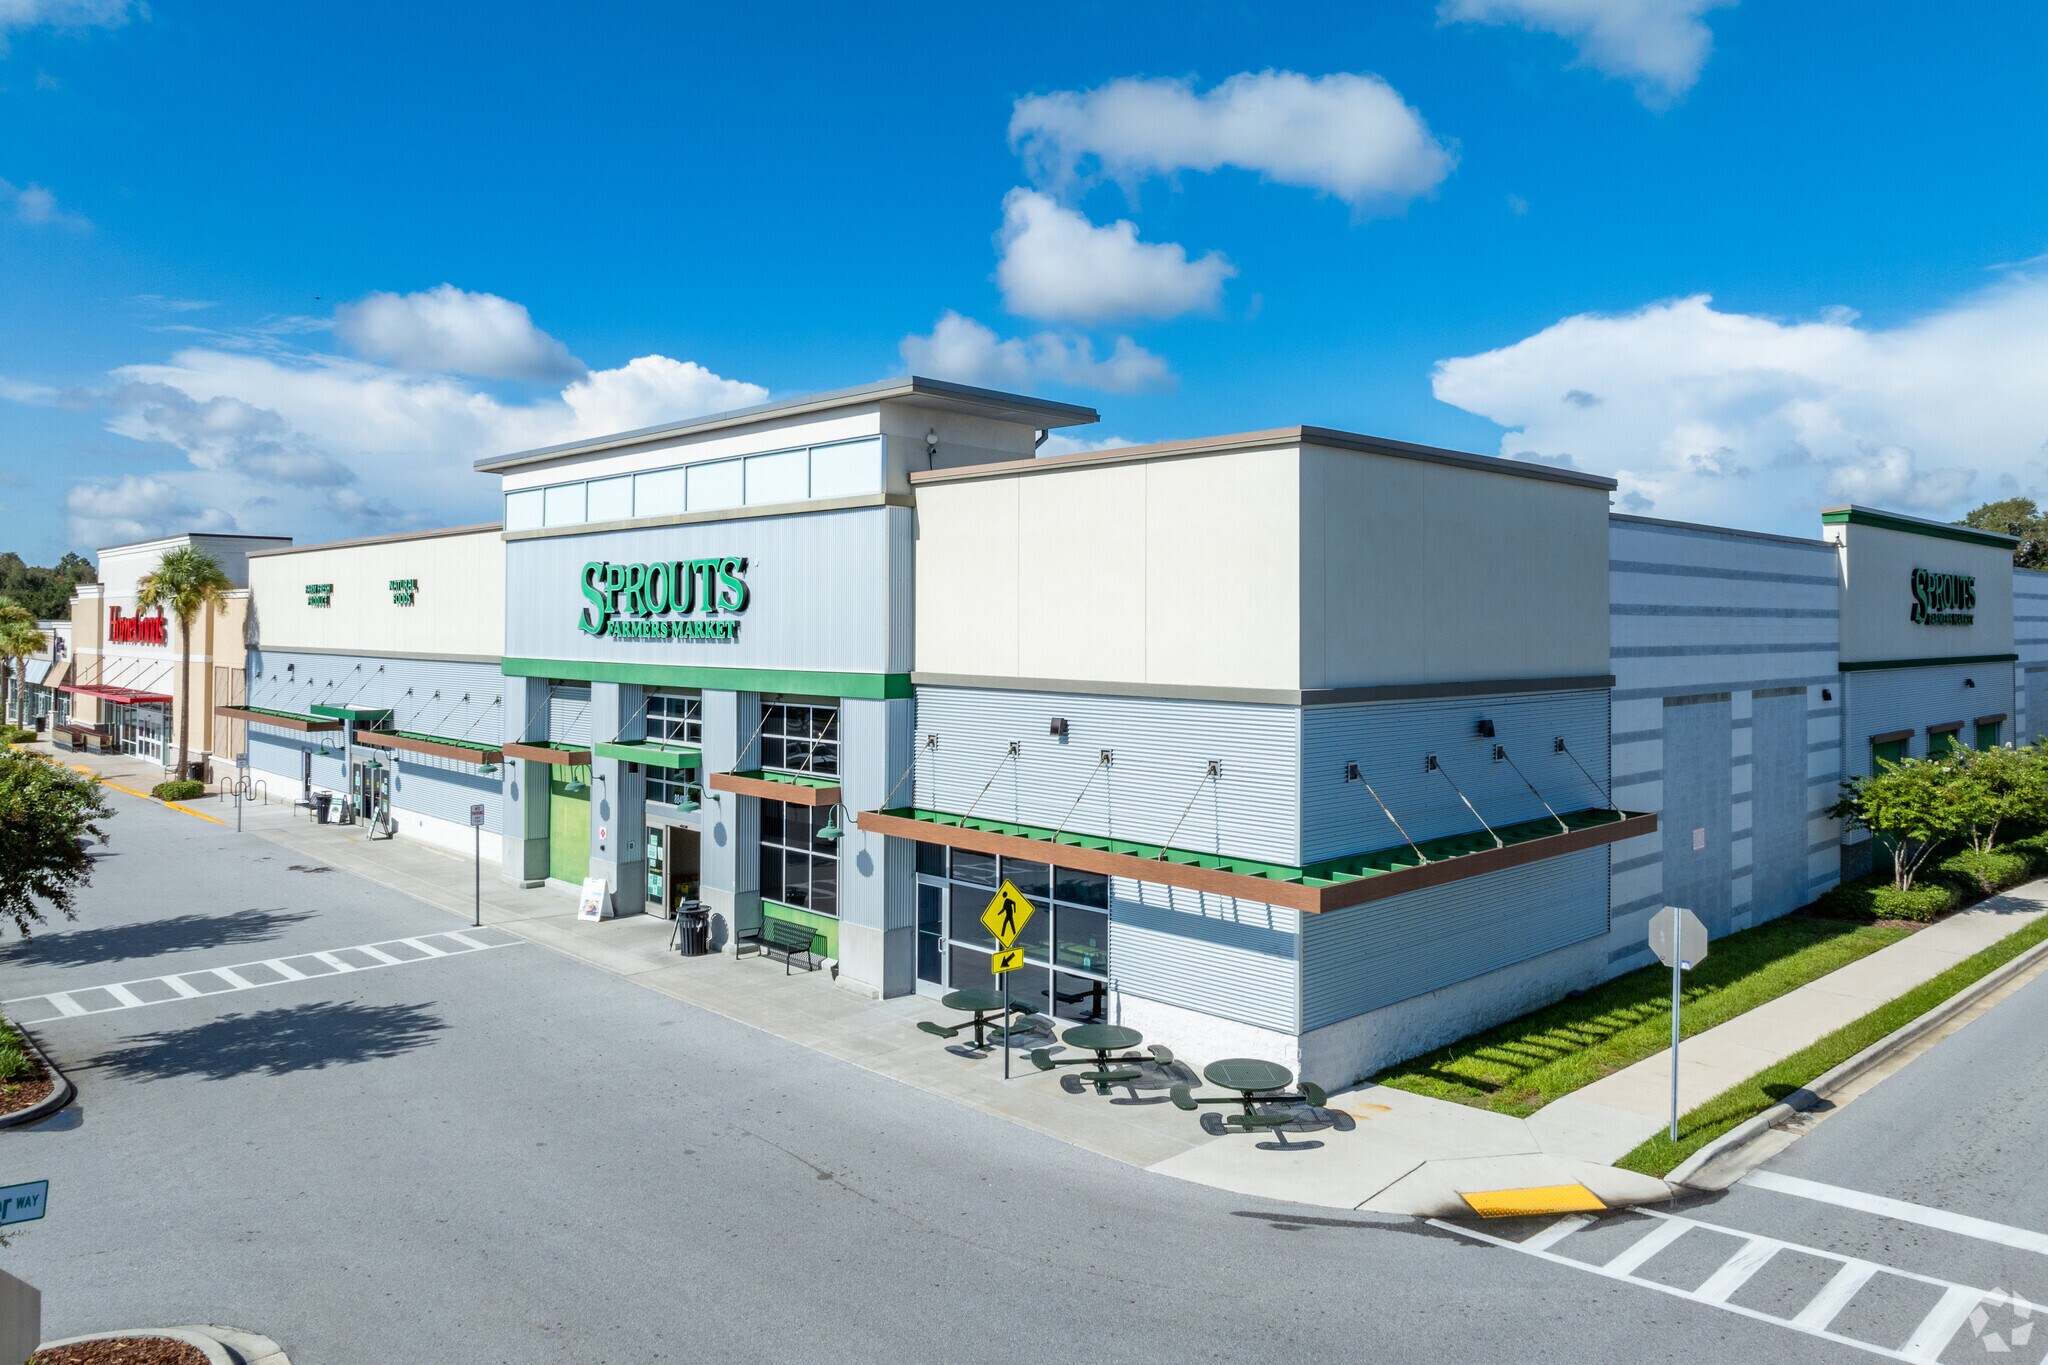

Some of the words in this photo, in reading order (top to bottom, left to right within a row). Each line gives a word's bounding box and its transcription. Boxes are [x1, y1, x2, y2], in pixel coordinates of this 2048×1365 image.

[389, 579, 416, 591] NATURAL
[578, 557, 747, 634] SPROUTS
[1912, 568, 1976, 624] SPROUTS
[607, 620, 668, 638] FARMERS
[672, 620, 737, 638] MARKET
[0, 1198, 12, 1220] r
[16, 1194, 39, 1209] WAY
